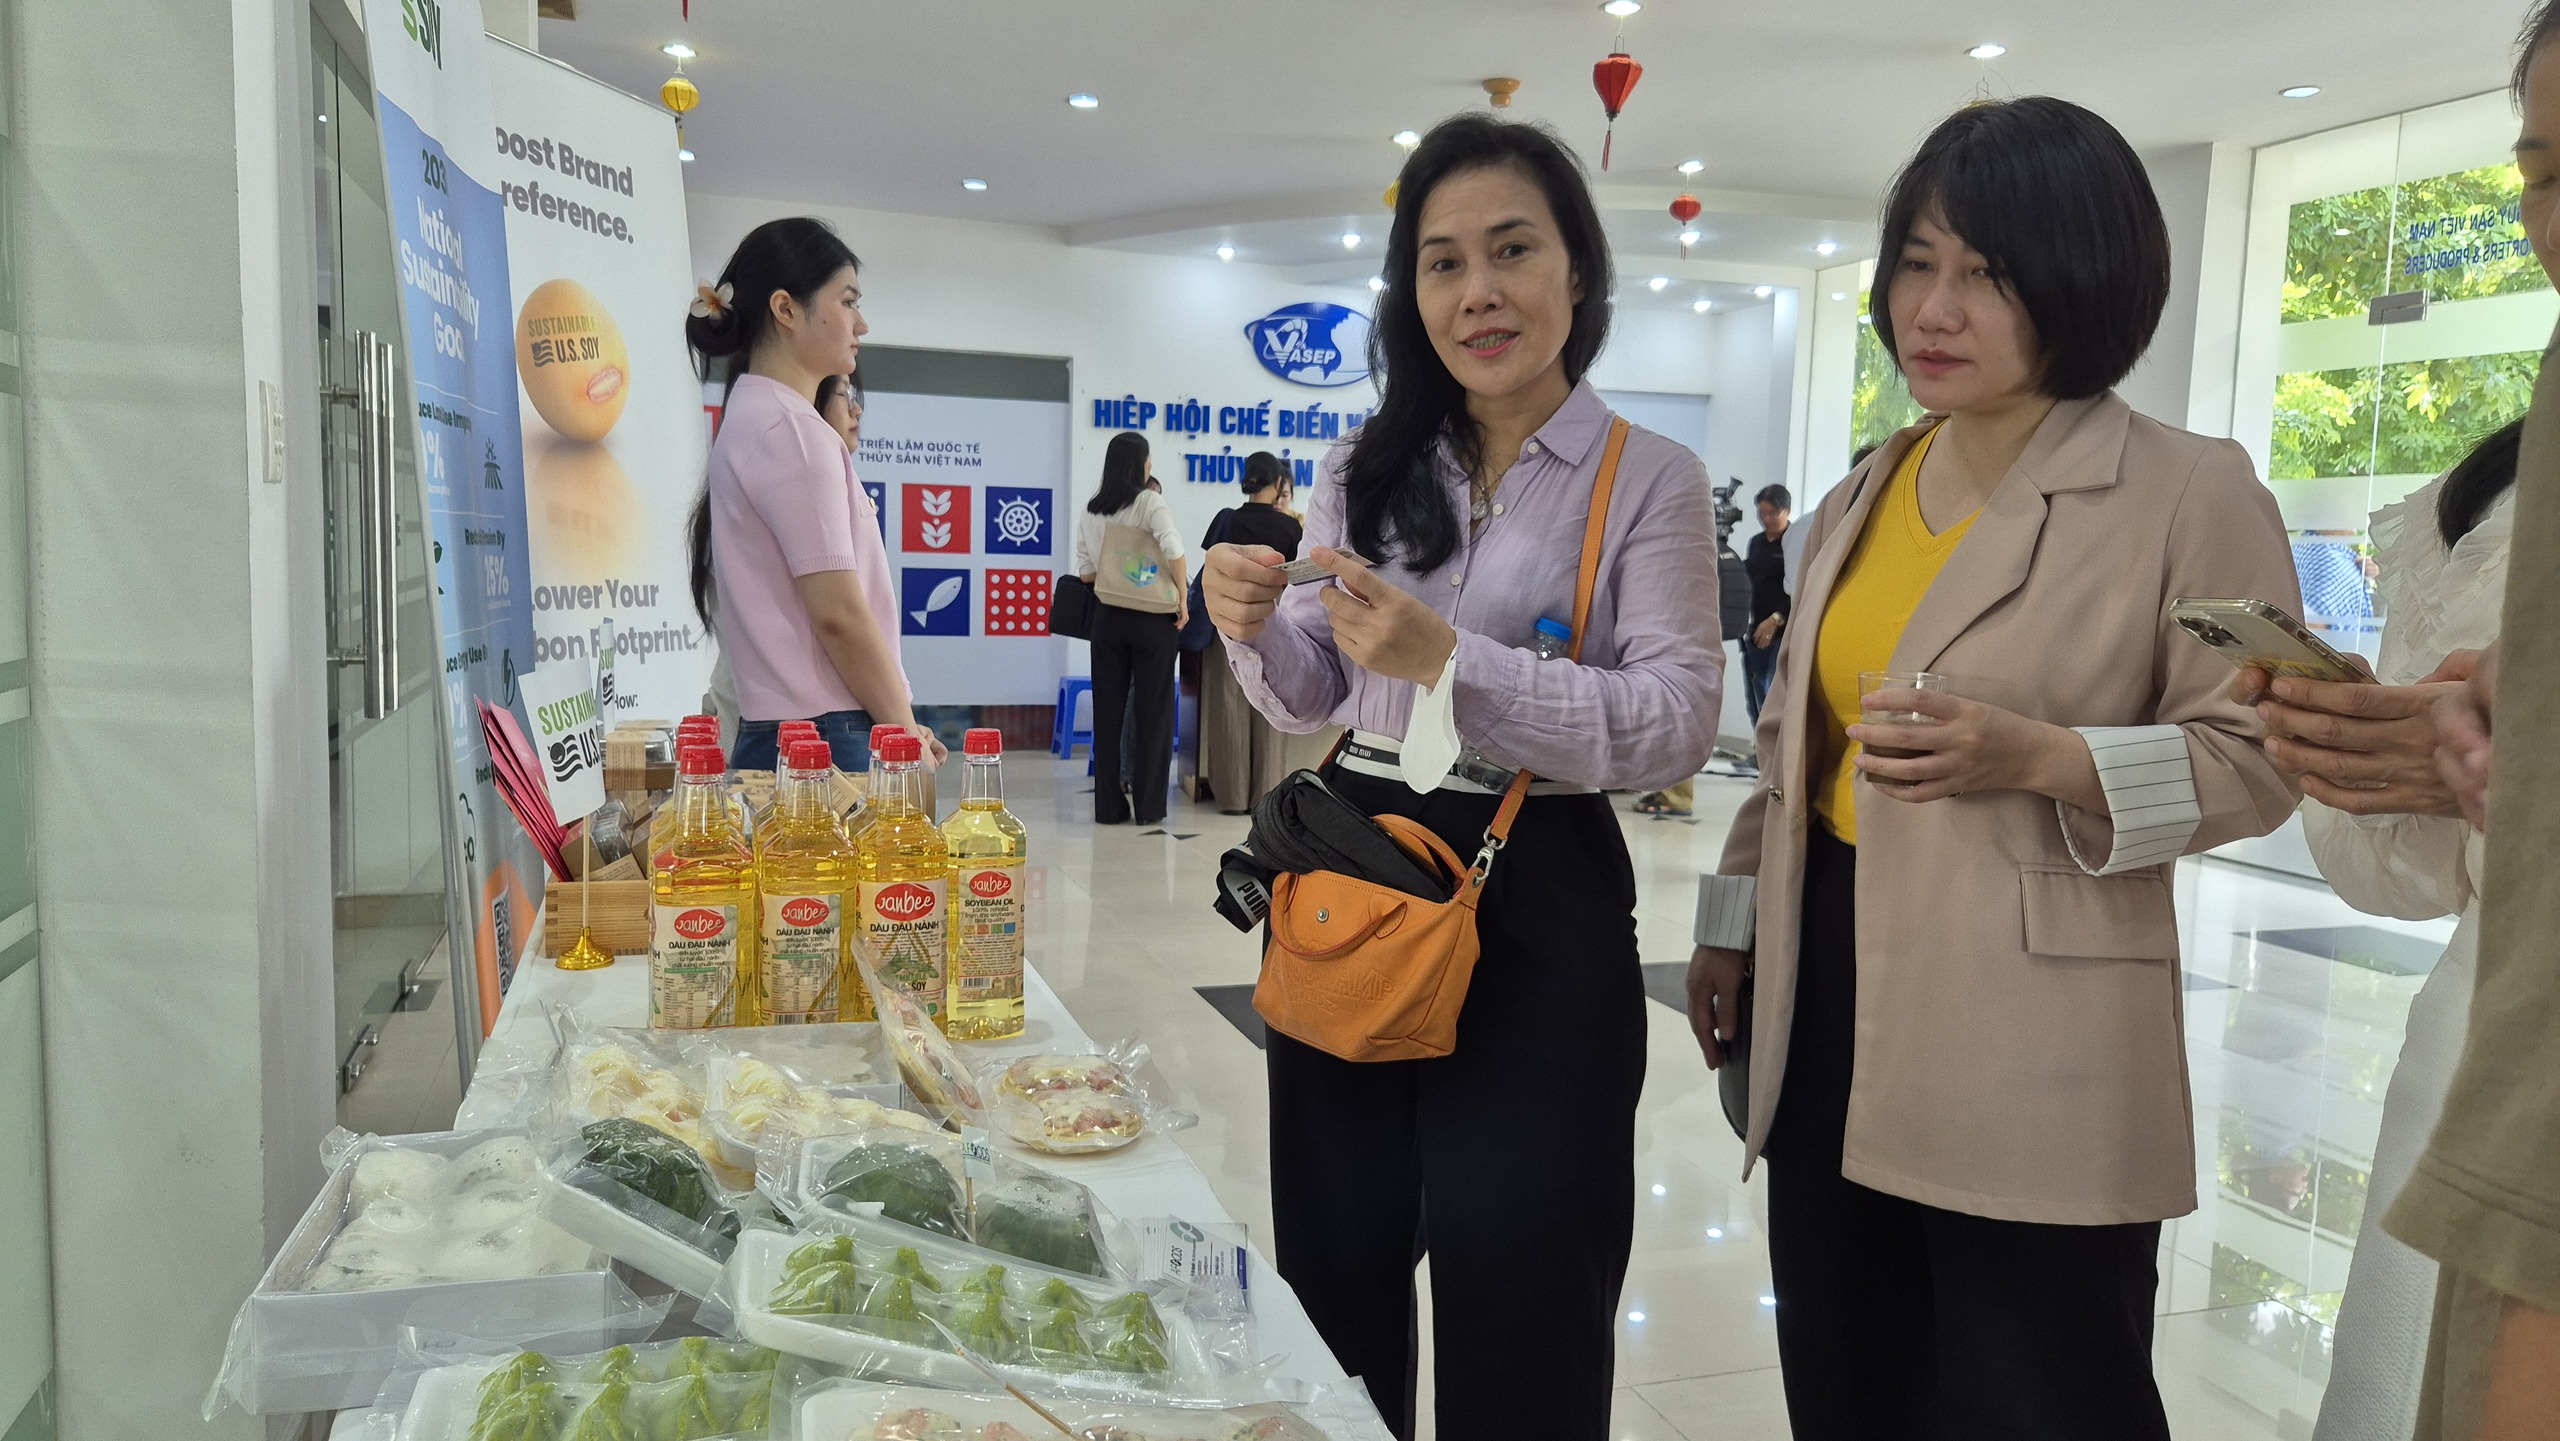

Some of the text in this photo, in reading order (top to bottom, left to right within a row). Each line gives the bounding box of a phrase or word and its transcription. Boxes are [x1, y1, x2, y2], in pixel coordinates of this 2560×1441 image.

[558, 140, 634, 198] Brand
[501, 180, 634, 244] reference.
[527, 315, 596, 337] SUSTAINABLE
[554, 336, 600, 363] U.S. SOY
[1263, 329, 1337, 369] VASEP
[1165, 398, 1210, 439] HỘI
[1220, 400, 1273, 436] CHẾ
[1278, 402, 1339, 440] BIẾN
[859, 436, 981, 454] TRIỂN LÃM QUỐC TẾ
[859, 451, 982, 467] THỦY SẢN VIỆT NAM
[532, 585, 603, 611] ower
[605, 579, 659, 608] Your
[590, 621, 698, 665] Fotprint.
[468, 646, 482, 664] Use
[970, 876, 1010, 892] Janbee
[782, 903, 828, 921] Janbee
[876, 890, 934, 914] Janbee
[964, 898, 1015, 907] SOYBEAN OIL
[674, 915, 724, 934] Janbee
[911, 981, 926, 991] SOY
